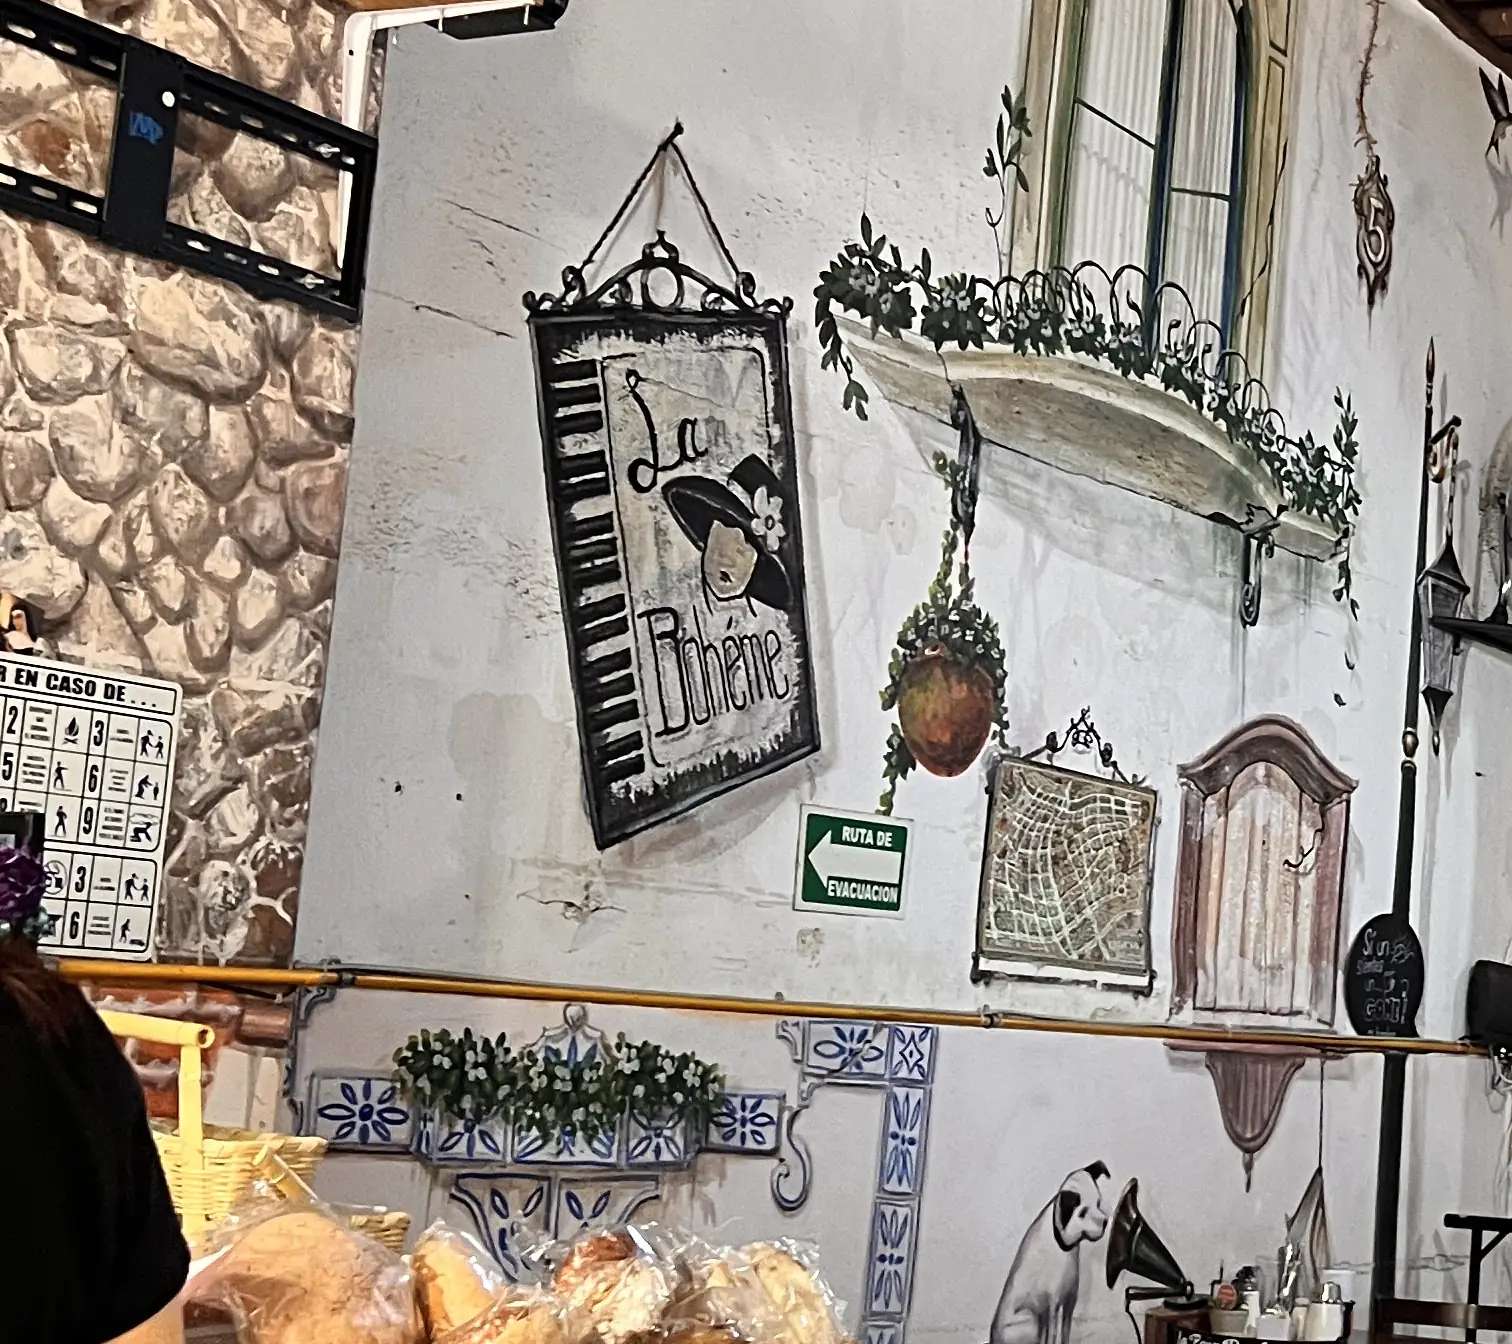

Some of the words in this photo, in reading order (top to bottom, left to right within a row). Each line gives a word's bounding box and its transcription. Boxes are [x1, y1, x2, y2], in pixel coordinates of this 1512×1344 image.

[1364, 197, 1385, 264] 5
[626, 368, 708, 493] La
[14, 667, 39, 688] EN
[46, 673, 97, 697] CASO
[6, 705, 19, 735] 2
[93, 719, 105, 747] 3
[2, 751, 14, 781] 5
[88, 764, 100, 793] 6
[83, 806, 95, 835] 9
[841, 825, 874, 846] RUTA
[876, 830, 893, 848] DE
[74, 865, 87, 893] 3
[827, 879, 899, 904] EVACUACION
[69, 910, 80, 940] 6
